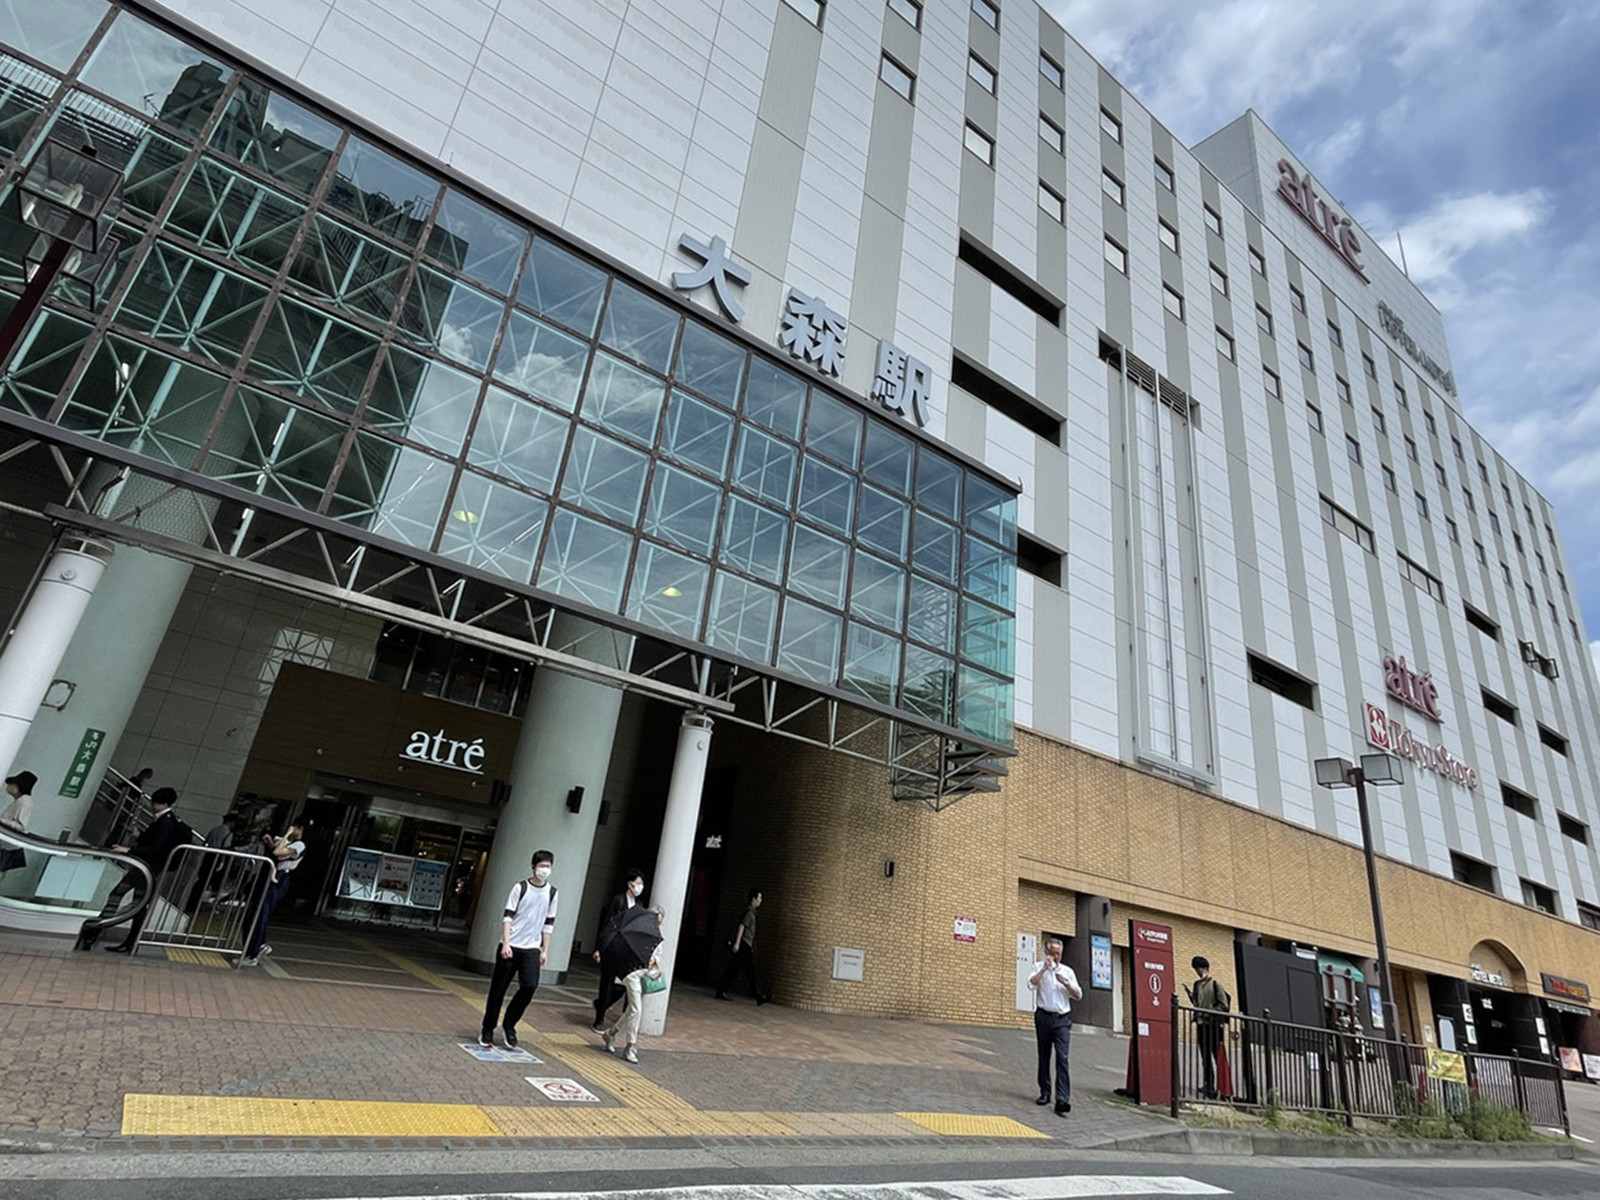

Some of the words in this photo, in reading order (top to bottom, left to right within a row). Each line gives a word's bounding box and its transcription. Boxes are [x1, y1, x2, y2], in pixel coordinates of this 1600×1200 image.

[671, 232, 932, 428] 大森駅
[405, 728, 486, 771] atré
